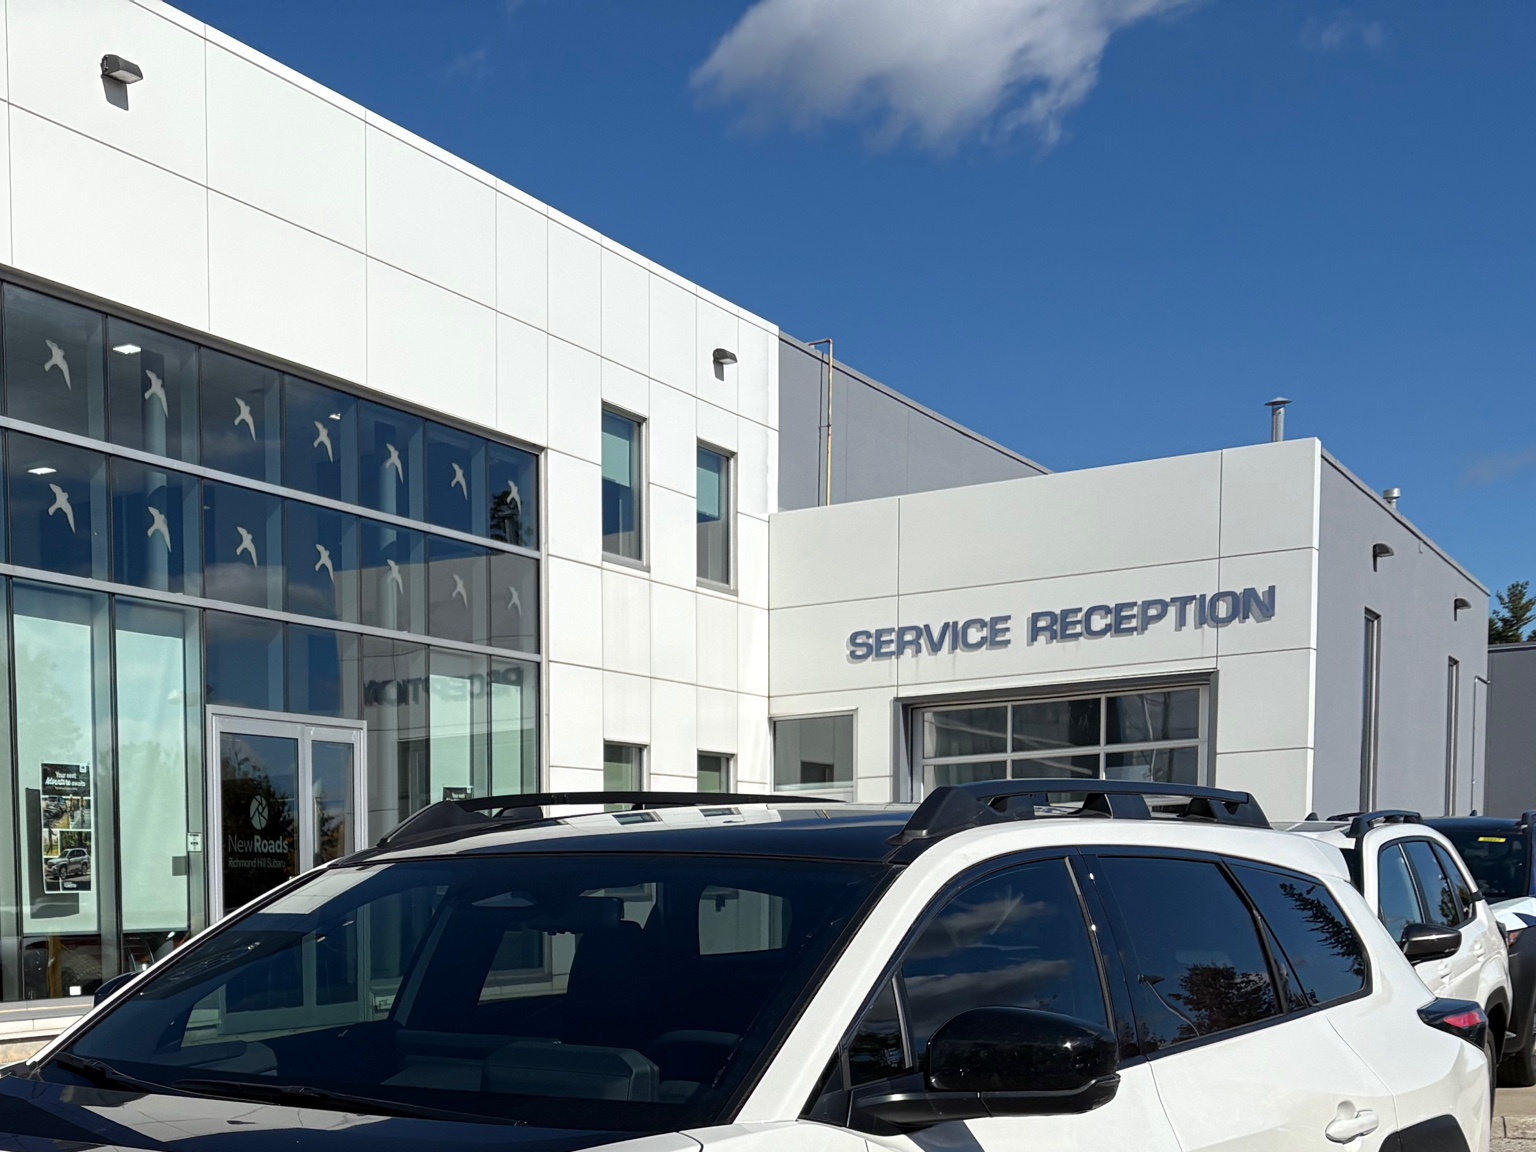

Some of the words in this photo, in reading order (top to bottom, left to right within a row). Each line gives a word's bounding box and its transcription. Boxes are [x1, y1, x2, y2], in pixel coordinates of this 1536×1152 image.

[848, 615, 1012, 660] SERVICE
[1029, 585, 1276, 643] RECEPTION
[228, 857, 257, 868] Richmond
[257, 858, 267, 868] Hill
[267, 857, 286, 869] Subaru
